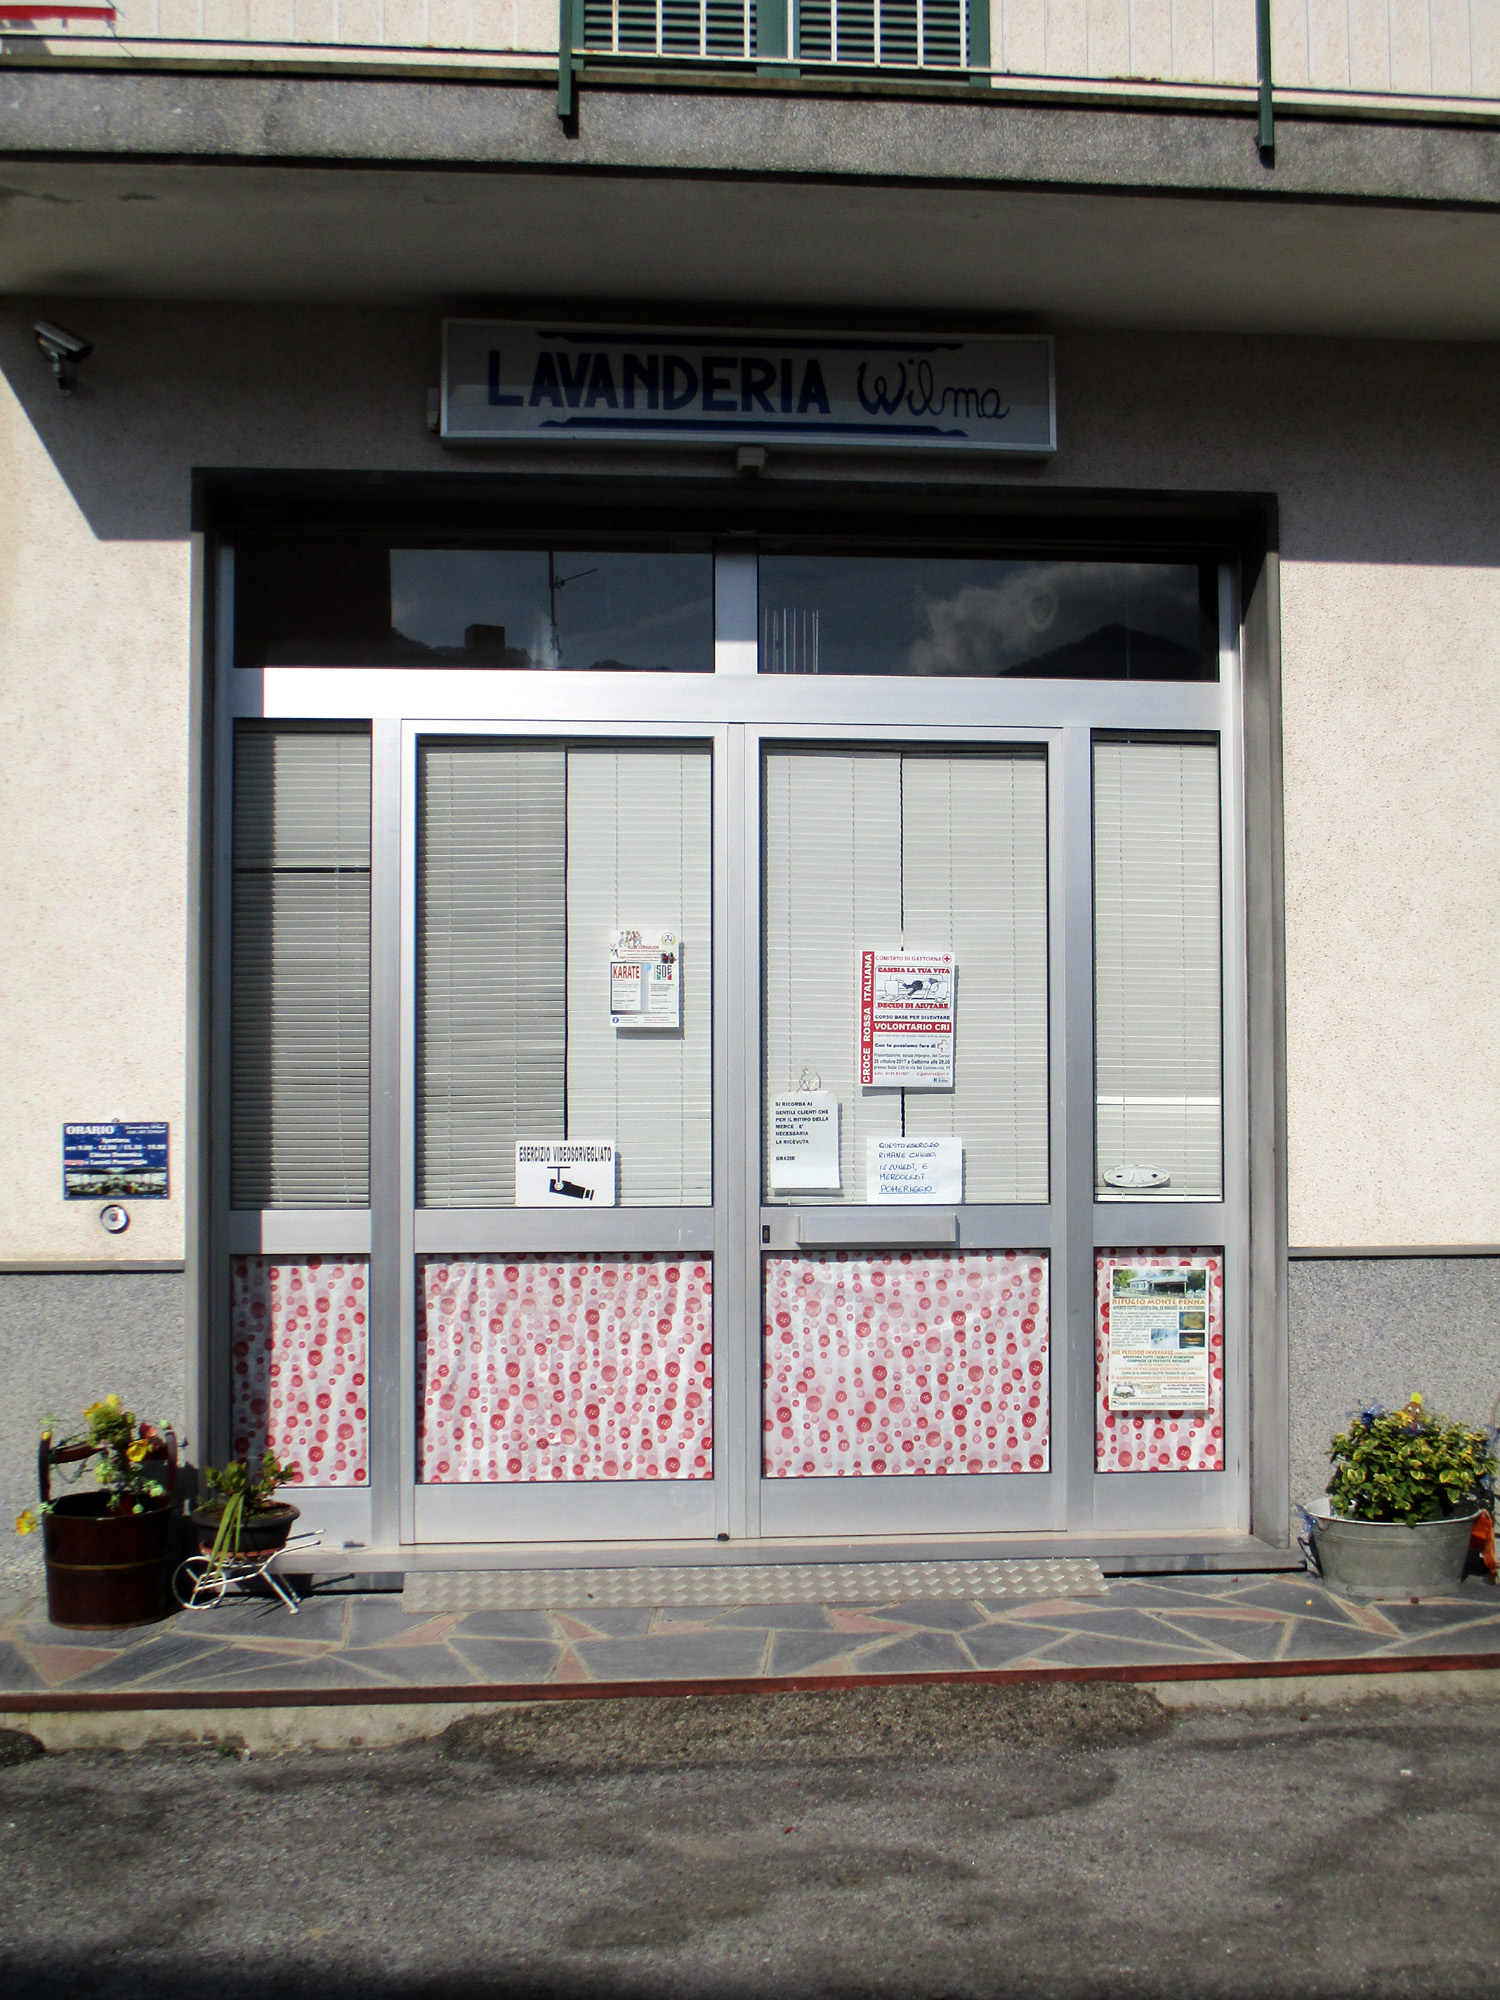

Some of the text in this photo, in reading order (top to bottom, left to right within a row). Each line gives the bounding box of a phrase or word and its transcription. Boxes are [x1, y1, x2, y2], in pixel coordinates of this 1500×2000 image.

[487, 350, 1011, 419] LAVANDERIA Wilma
[613, 965, 640, 979] KARATE
[862, 953, 873, 1083] CROCE ROSSA ITALIANA
[874, 1023, 950, 1031] VOLONTARIO CRI
[66, 1125, 115, 1135] ORARIO
[519, 1146, 612, 1162] ESERCIZIO VIDEOSORVEGLIATO
[922, 1162, 929, 1170] E
